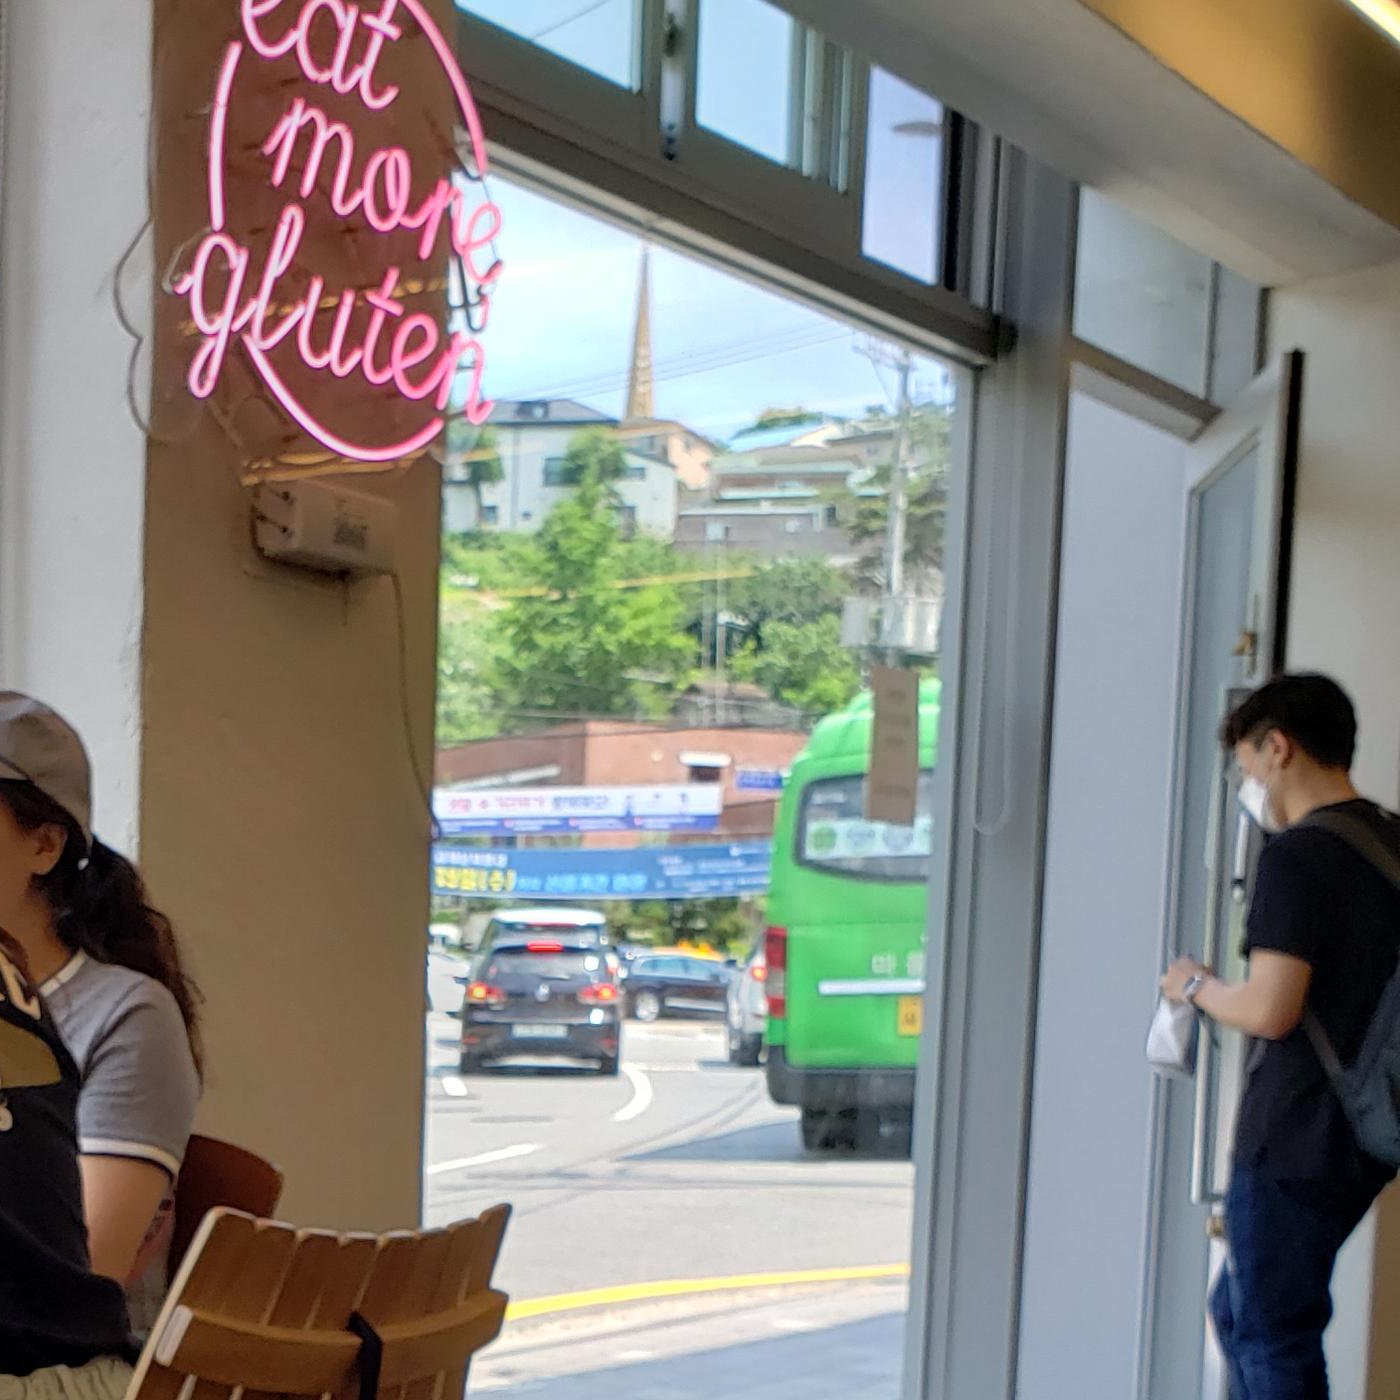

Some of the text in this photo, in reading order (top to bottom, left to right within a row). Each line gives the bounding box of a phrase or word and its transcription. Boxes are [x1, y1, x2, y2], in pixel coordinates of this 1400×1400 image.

[240, 0, 402, 109] eat
[262, 97, 504, 285] more
[173, 203, 496, 427] gluten
